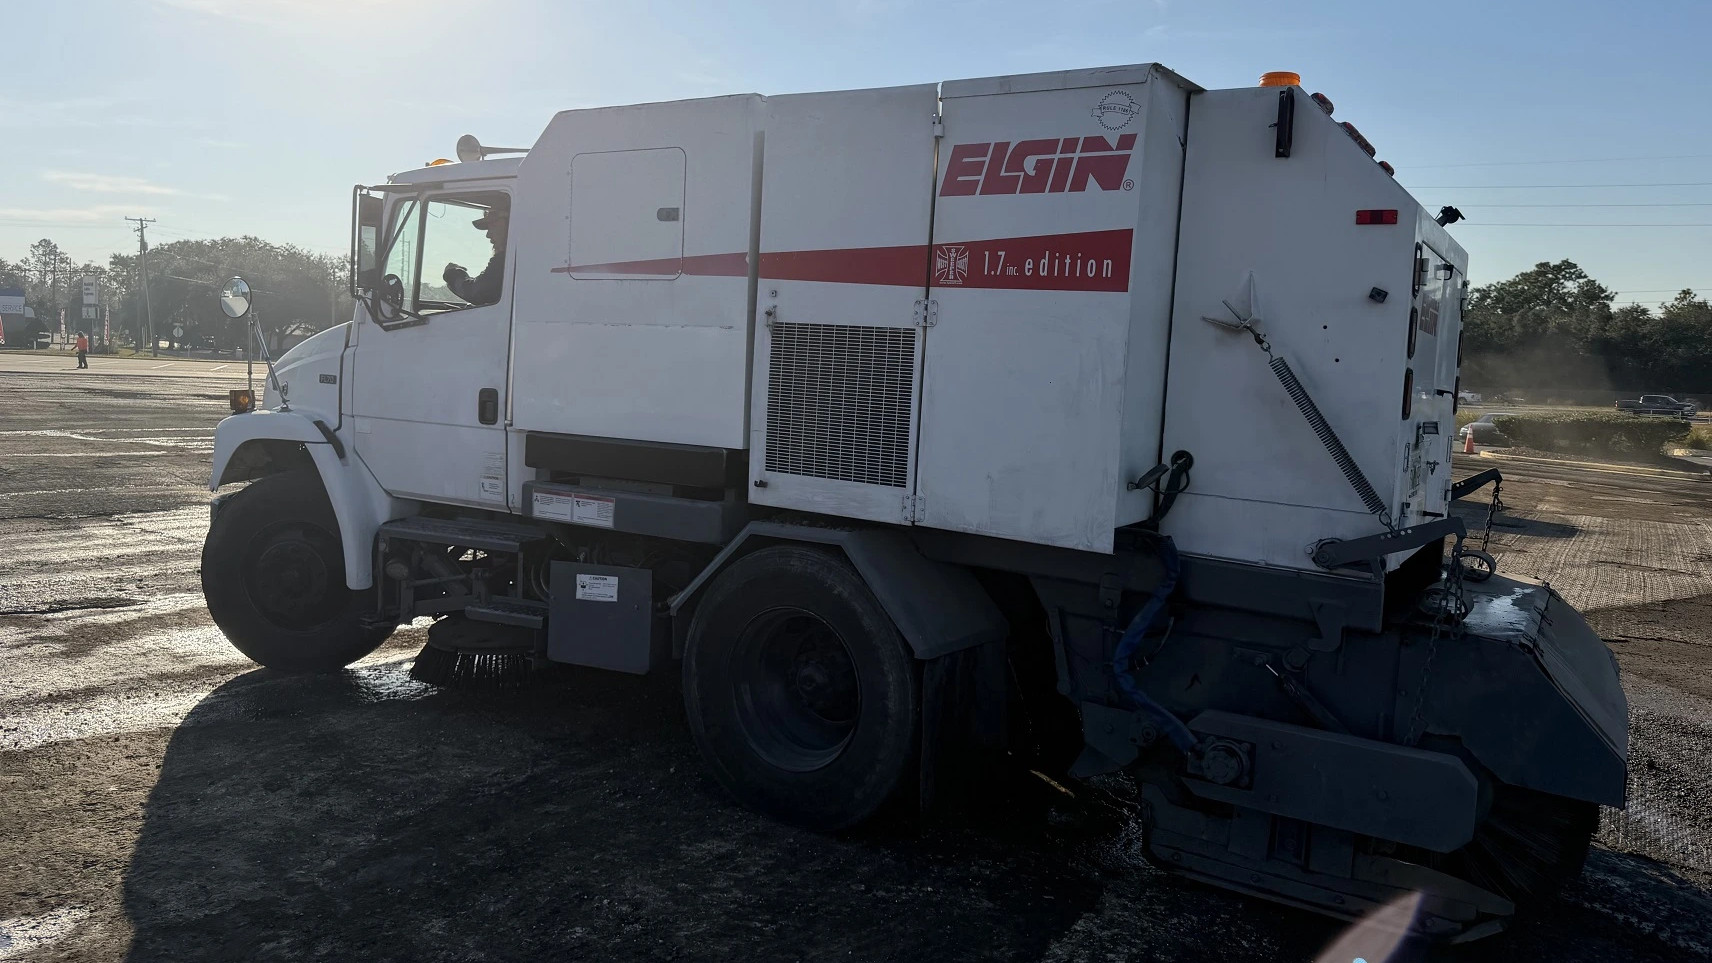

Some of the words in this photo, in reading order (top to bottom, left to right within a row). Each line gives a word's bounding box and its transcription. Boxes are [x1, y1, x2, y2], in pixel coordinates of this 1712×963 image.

[939, 134, 1137, 197] ELGIN
[984, 251, 1006, 275] 1.7
[1006, 263, 1019, 276] inc.
[1024, 251, 1113, 278] edition
